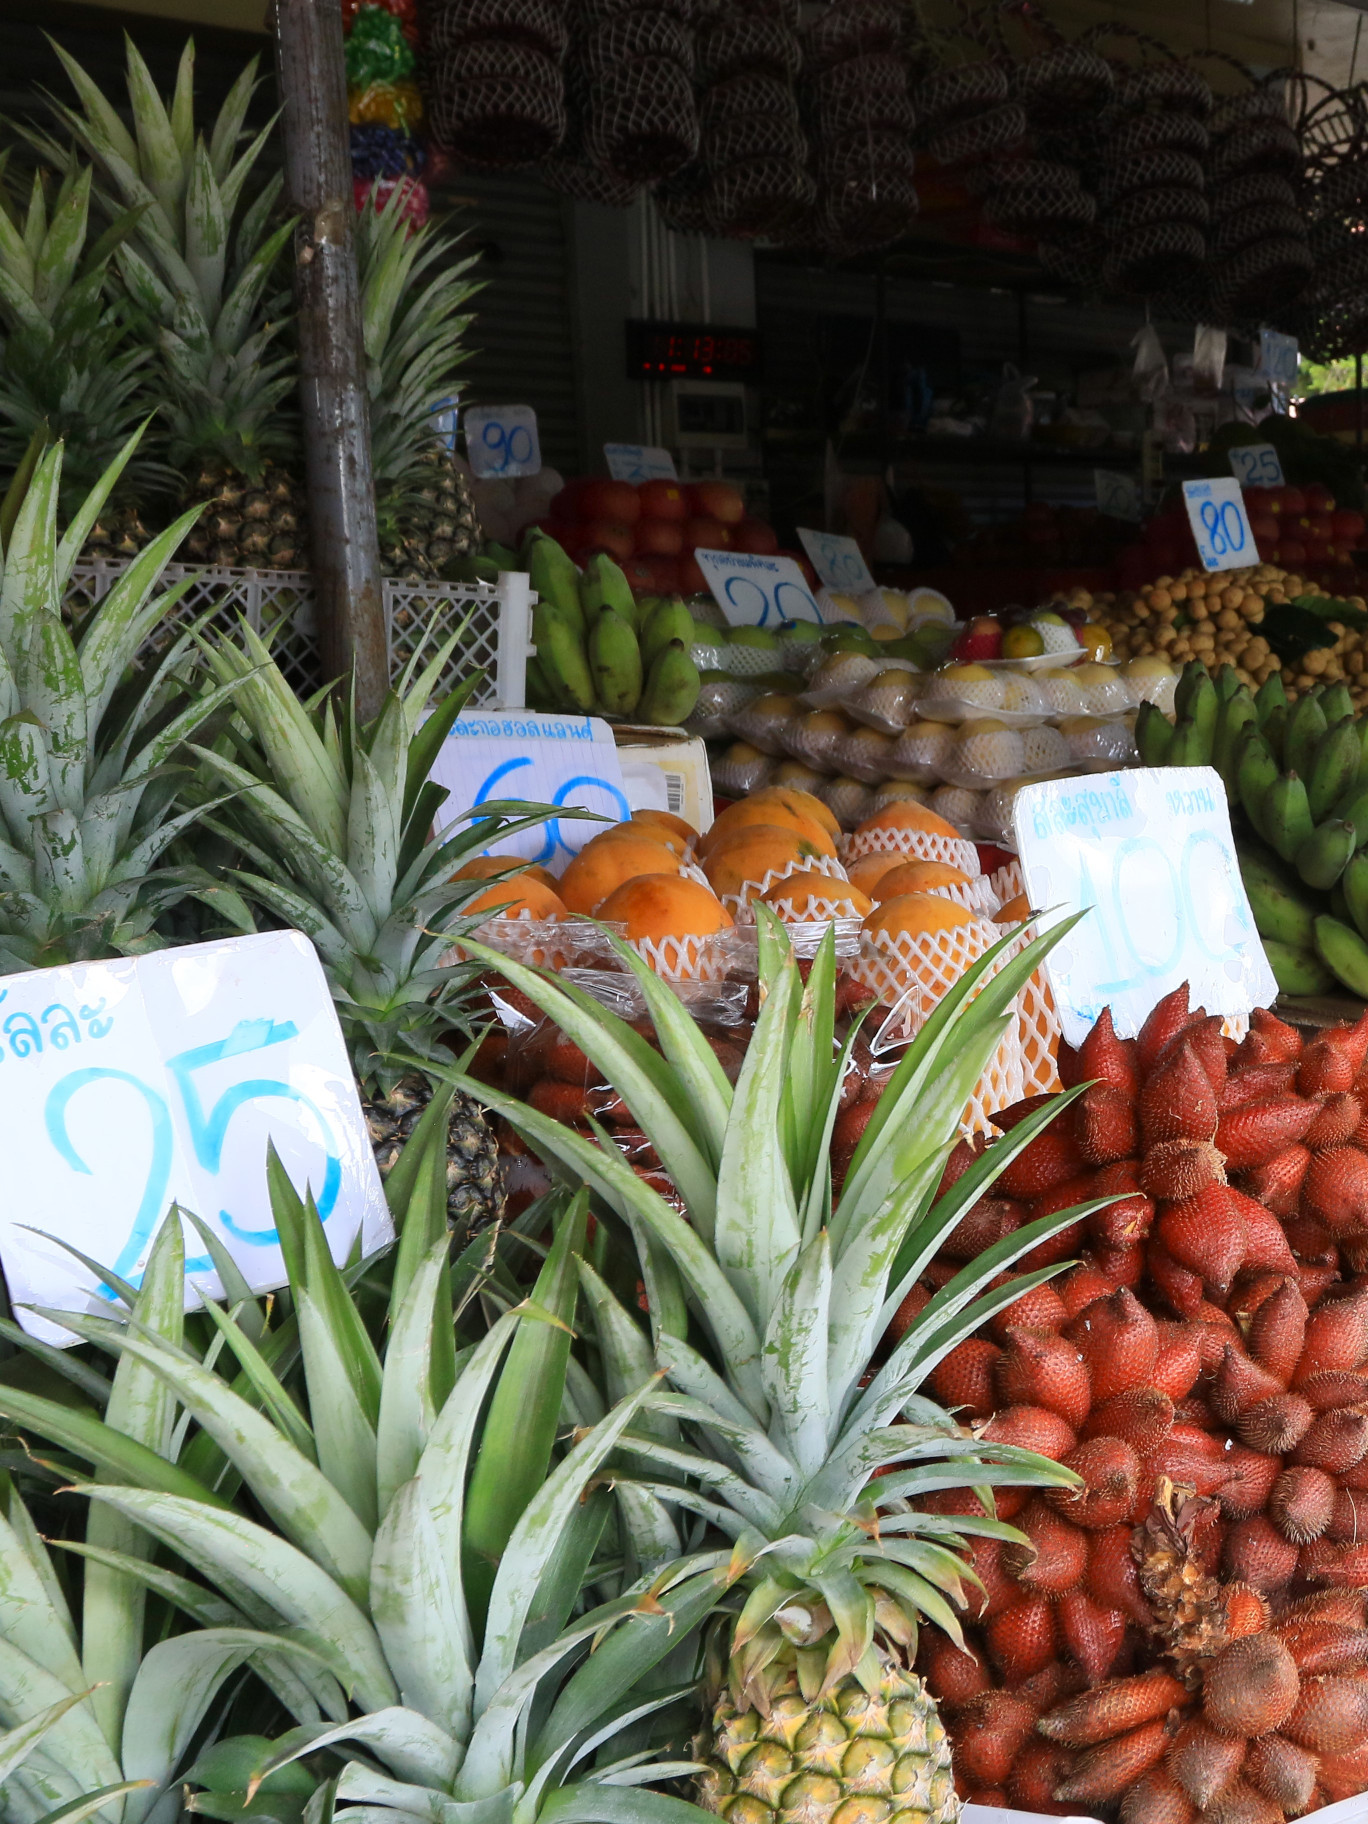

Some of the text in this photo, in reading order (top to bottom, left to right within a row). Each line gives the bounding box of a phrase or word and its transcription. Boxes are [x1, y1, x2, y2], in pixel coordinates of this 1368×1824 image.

[482, 422, 533, 472] 90
[1241, 450, 1280, 482] 25
[1200, 501, 1245, 555] 80
[471, 756, 632, 866] 60
[1078, 829, 1249, 994] 100
[44, 1017, 342, 1302] 25
